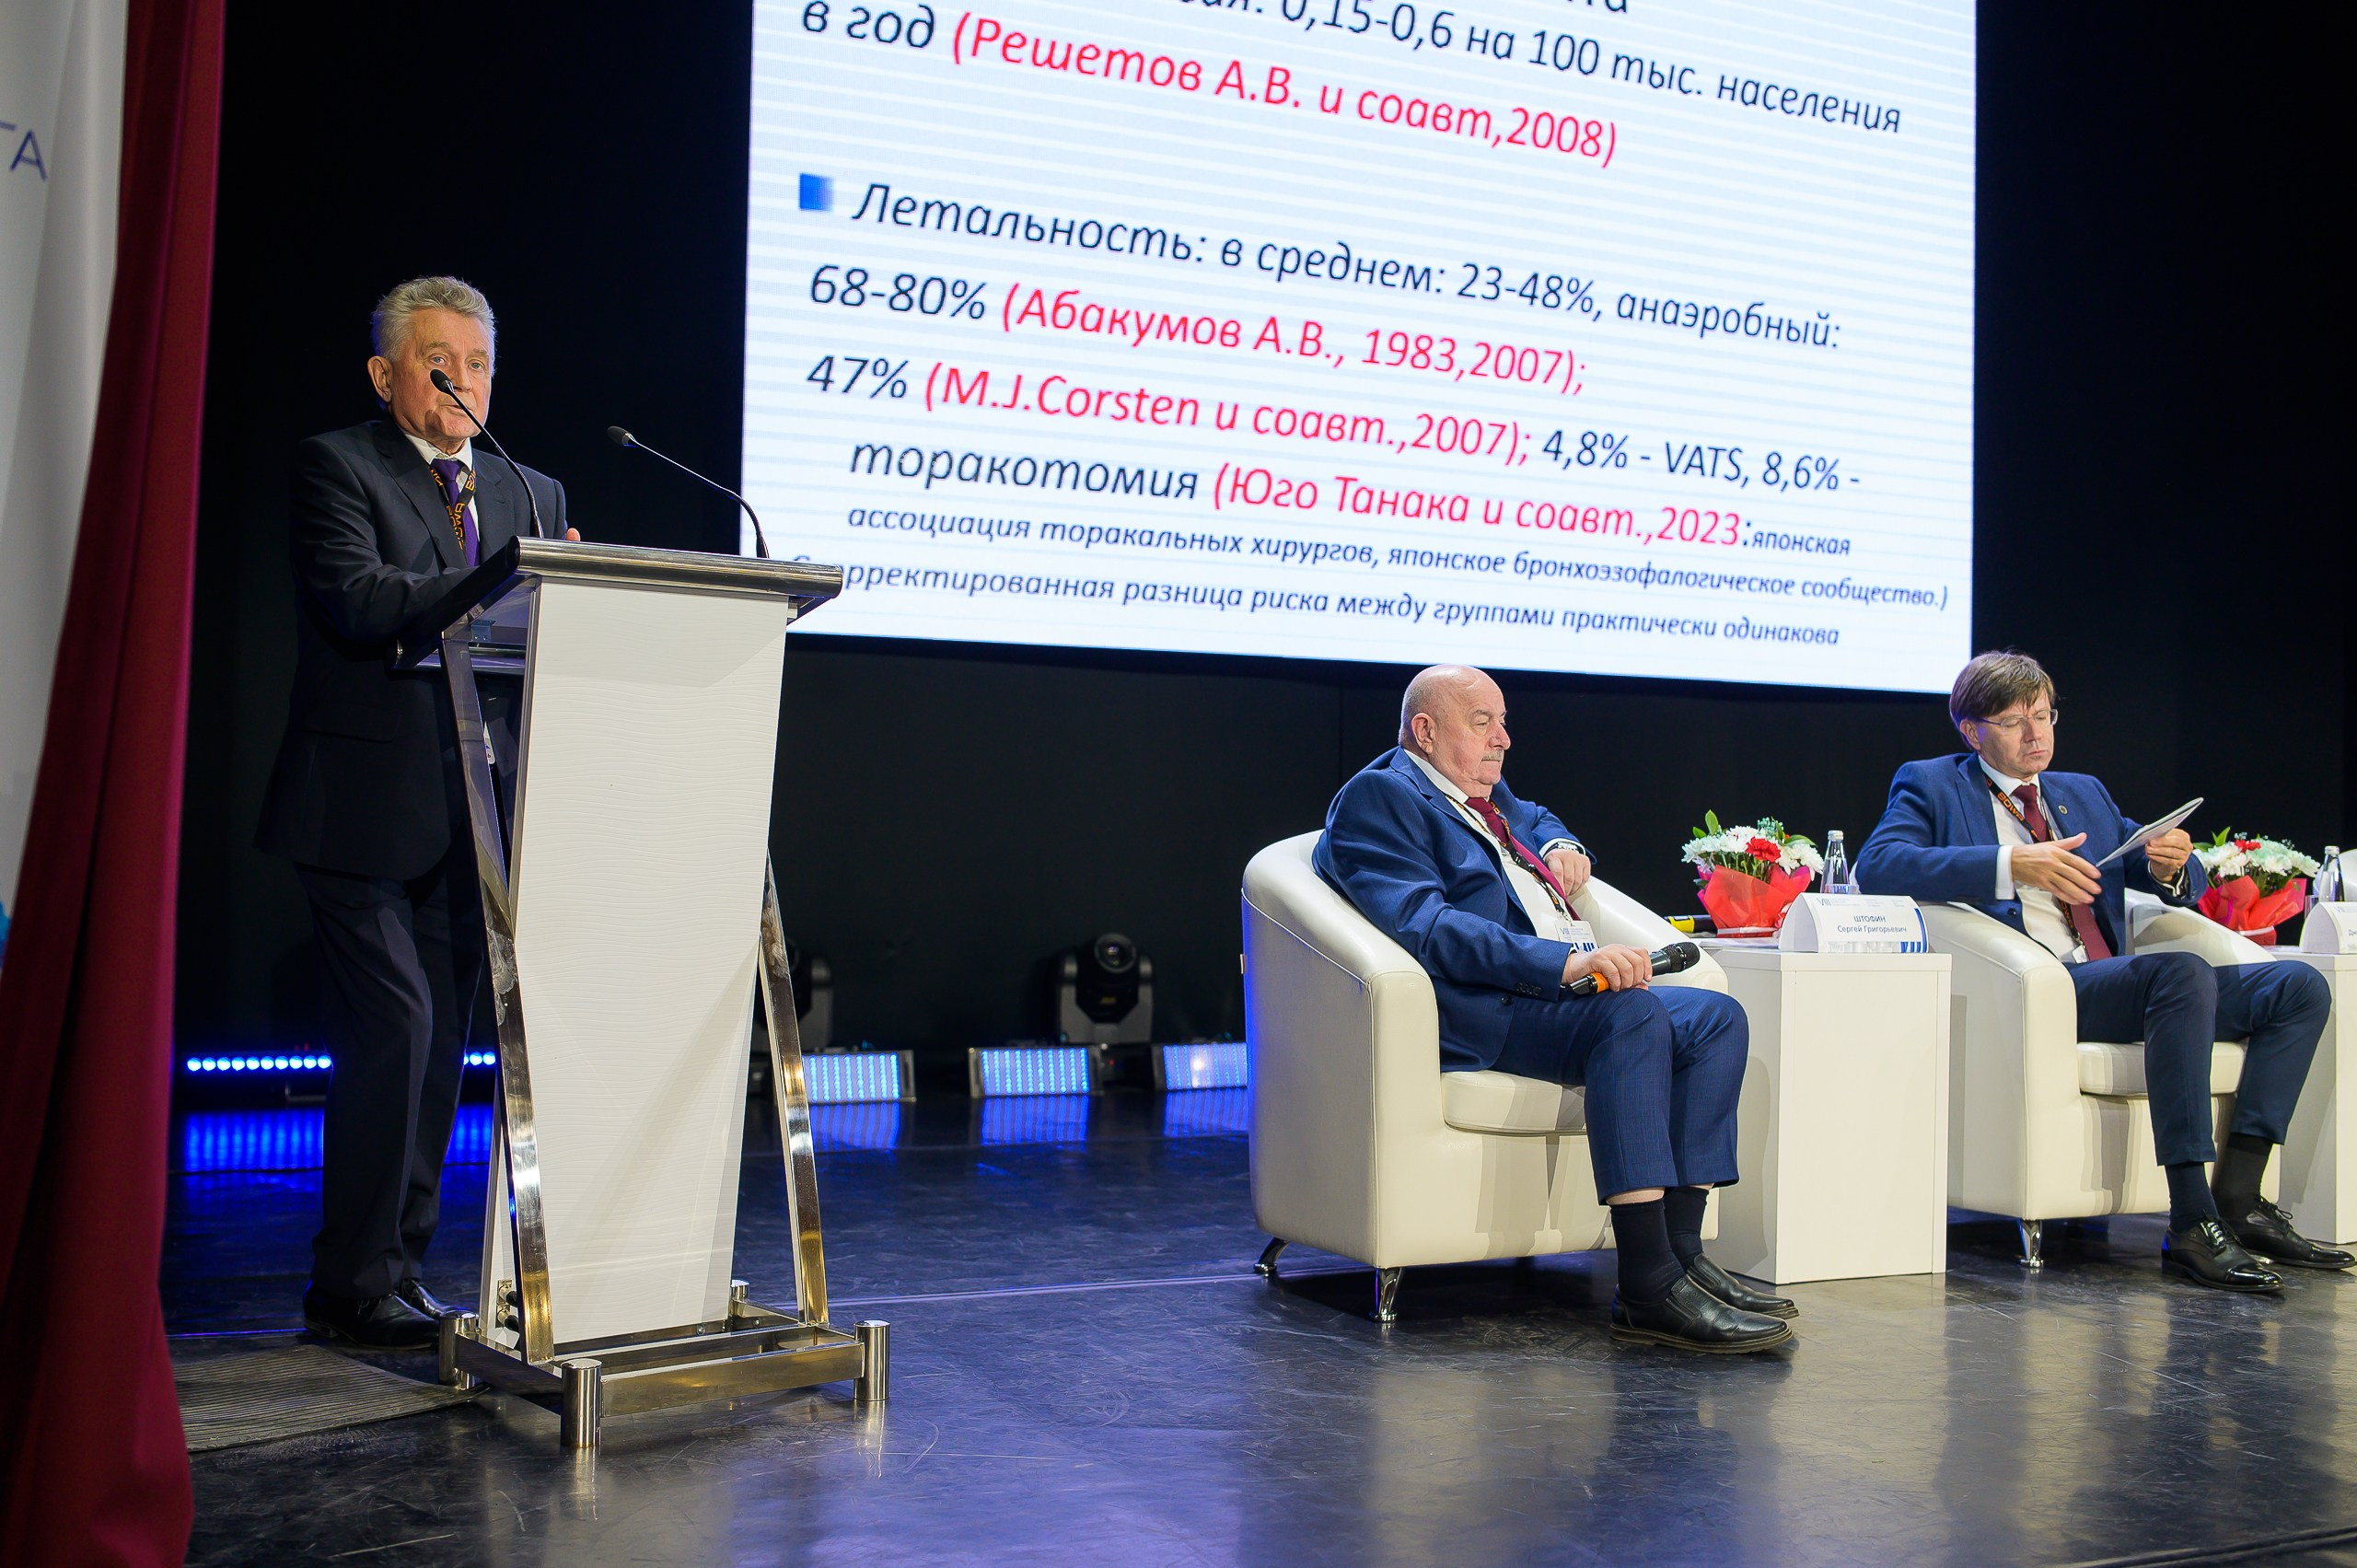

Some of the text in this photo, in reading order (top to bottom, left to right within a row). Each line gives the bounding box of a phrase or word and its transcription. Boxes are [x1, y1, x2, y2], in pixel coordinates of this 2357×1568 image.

[801, 0, 1616, 168] в год (Решетов А.В. и соавт,2008)
[1466, 25, 1515, 60] на
[1527, 29, 1600, 76] 100
[1611, 52, 1702, 95] тыс.
[1717, 74, 1901, 134] населения
[850, 182, 1840, 348] Летальность: в среднем: 23-48%, анаэробный:
[809, 263, 1585, 396] 68-80% (Абакумов А.В., 1983,2007);
[806, 354, 909, 399] 47%
[925, 362, 1200, 426] (M.J.Corsten
[1215, 401, 1239, 431] и
[1252, 405, 1531, 466] соавт.,2007);
[1541, 429, 1629, 470] 4,8%
[1665, 441, 1749, 488] VATS,
[1762, 450, 1840, 493] 8,6%
[850, 443, 1199, 500] торакотомия
[1213, 462, 1318, 510] (Юго
[1334, 475, 1469, 522] Танака
[1482, 500, 1504, 525] и
[848, 508, 1031, 542] ассоциация
[1039, 522, 1244, 553] торакальных
[1250, 537, 1378, 569] хирургов,
[1387, 548, 1506, 573] японское
[1801, 576, 1948, 610] сообщество.)
[1121, 582, 1243, 611] разница
[1249, 590, 1329, 613] риска
[1336, 592, 1427, 623] между
[1433, 603, 1555, 626] группами
[1562, 610, 1717, 636] практически
[1724, 616, 1840, 645] одинакова
[1997, 792, 2026, 822] BOWA
[1837, 925, 1908, 934] Сергей Григорьевич
